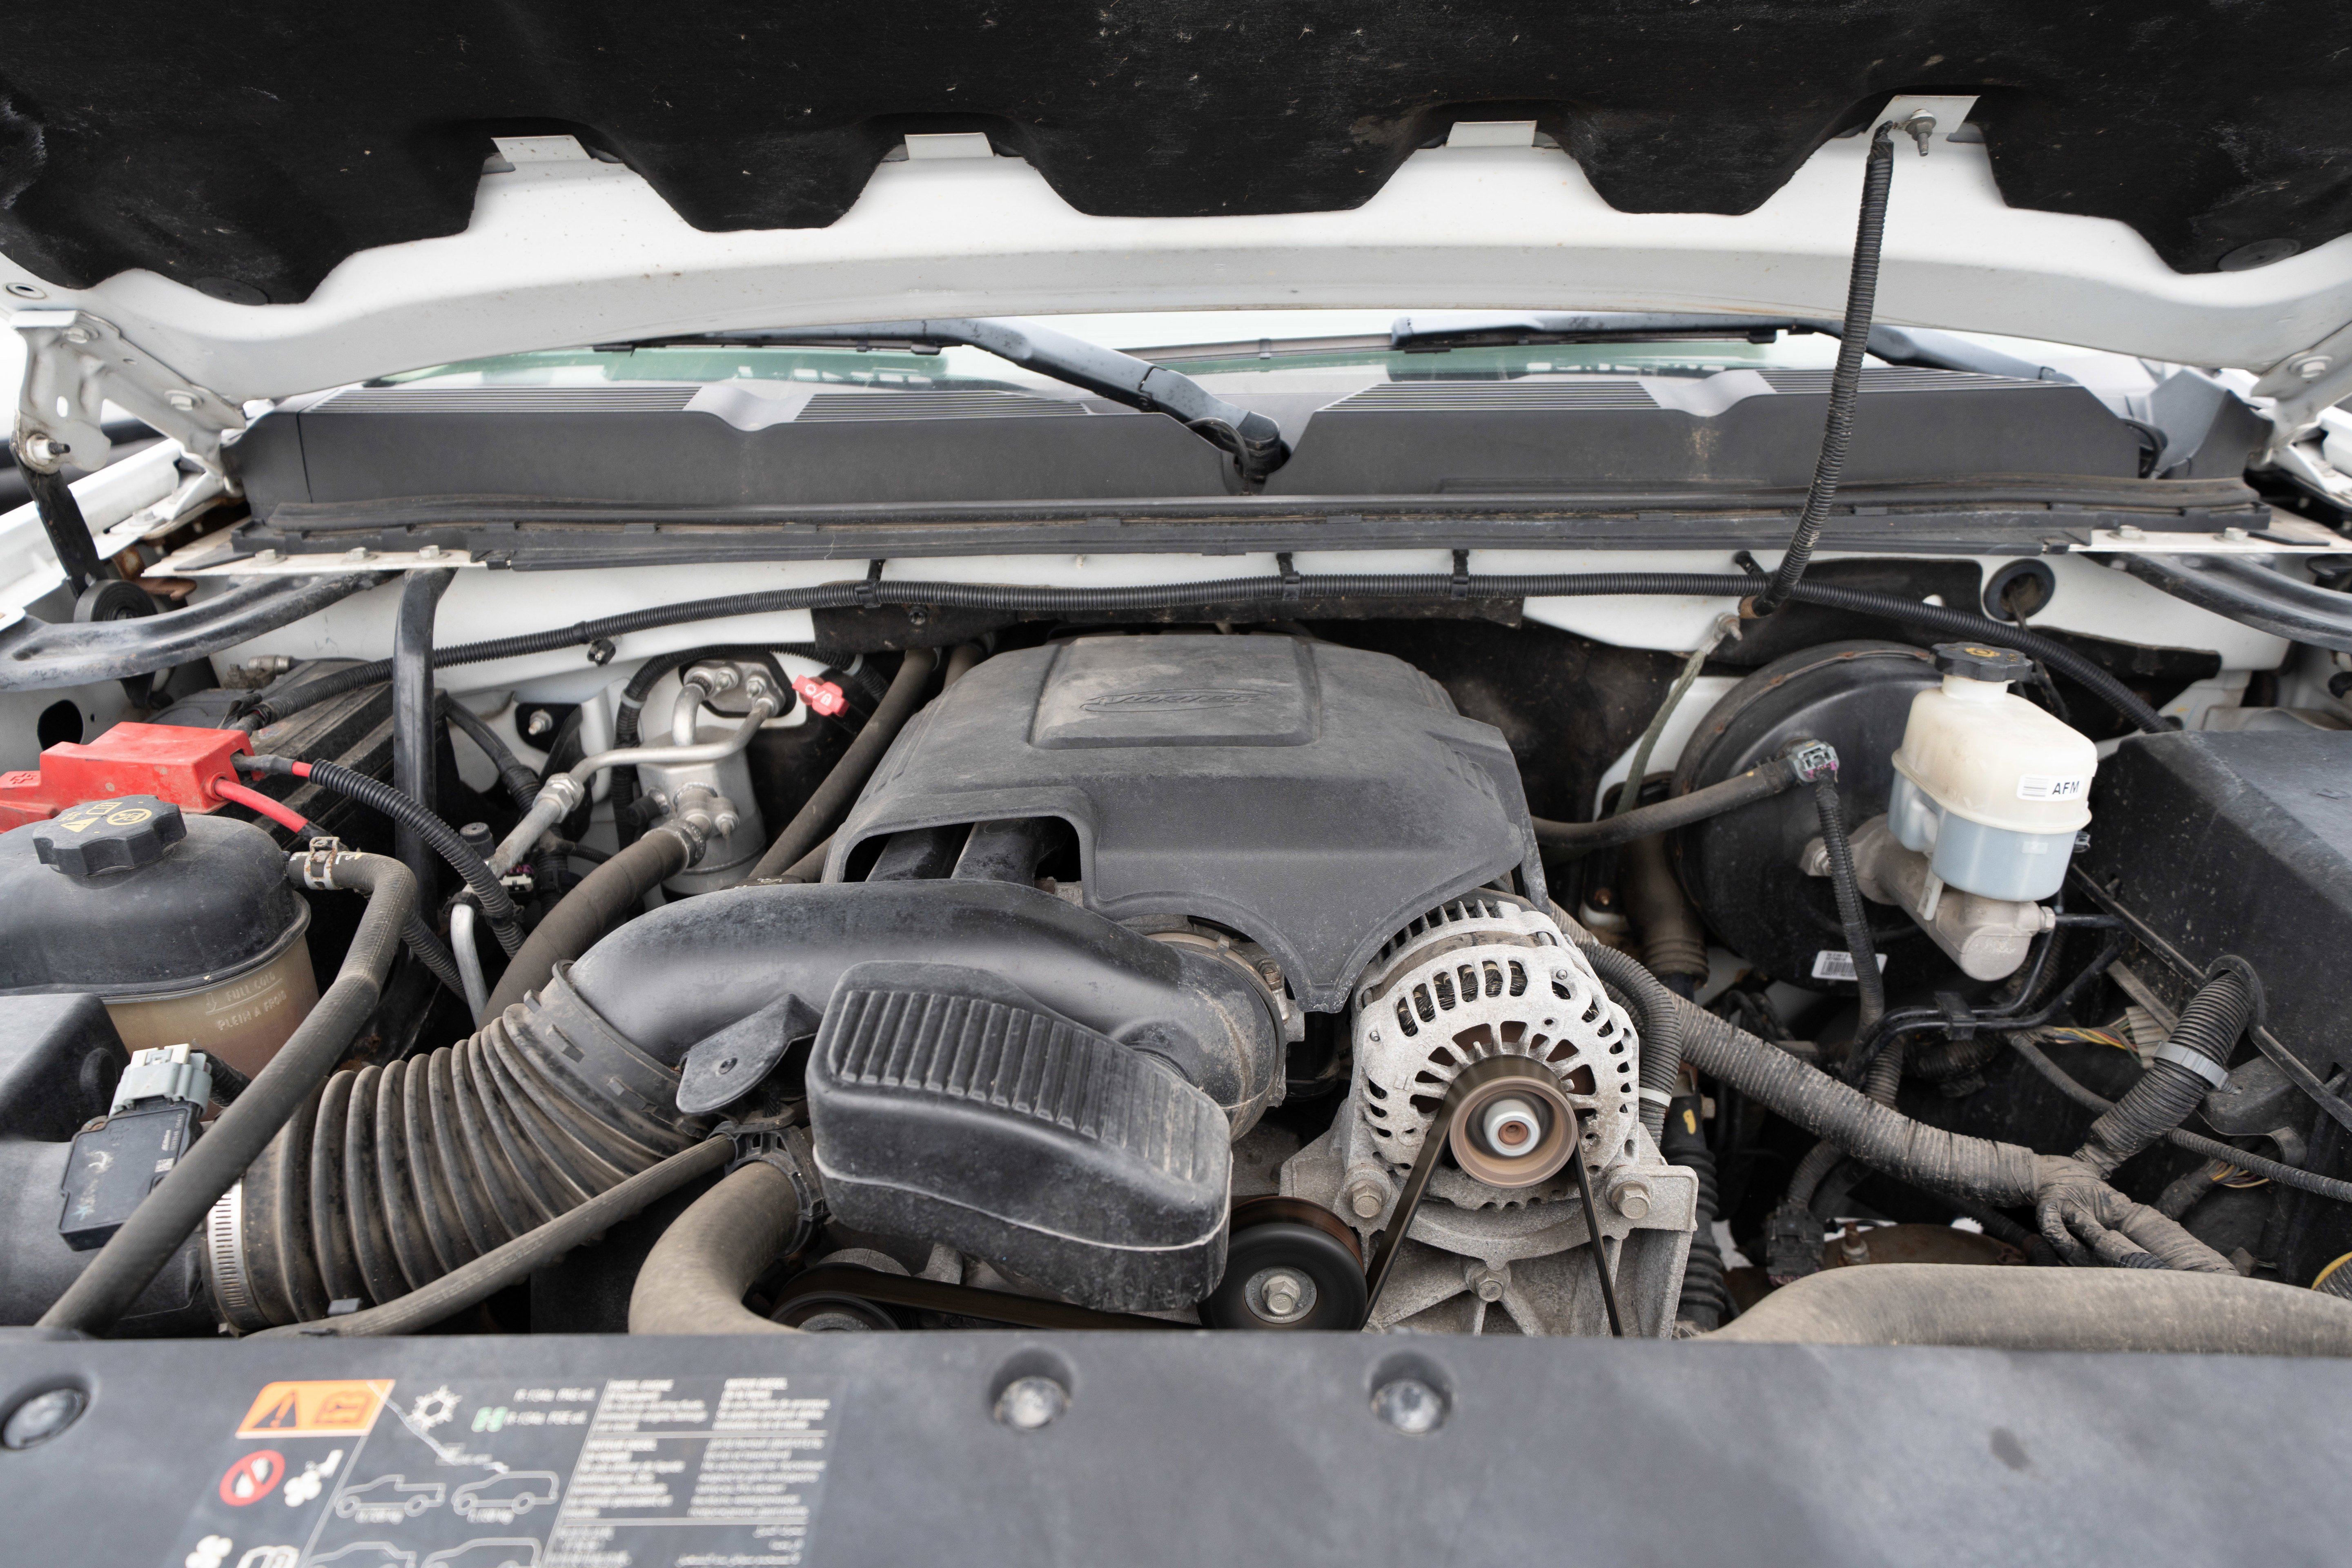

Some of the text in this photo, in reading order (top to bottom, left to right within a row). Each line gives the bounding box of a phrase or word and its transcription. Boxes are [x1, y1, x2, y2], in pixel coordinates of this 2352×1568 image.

[2051, 781, 2080, 795] AFM
[225, 984, 252, 1002] FULL
[217, 1010, 252, 1031] PLEIN
